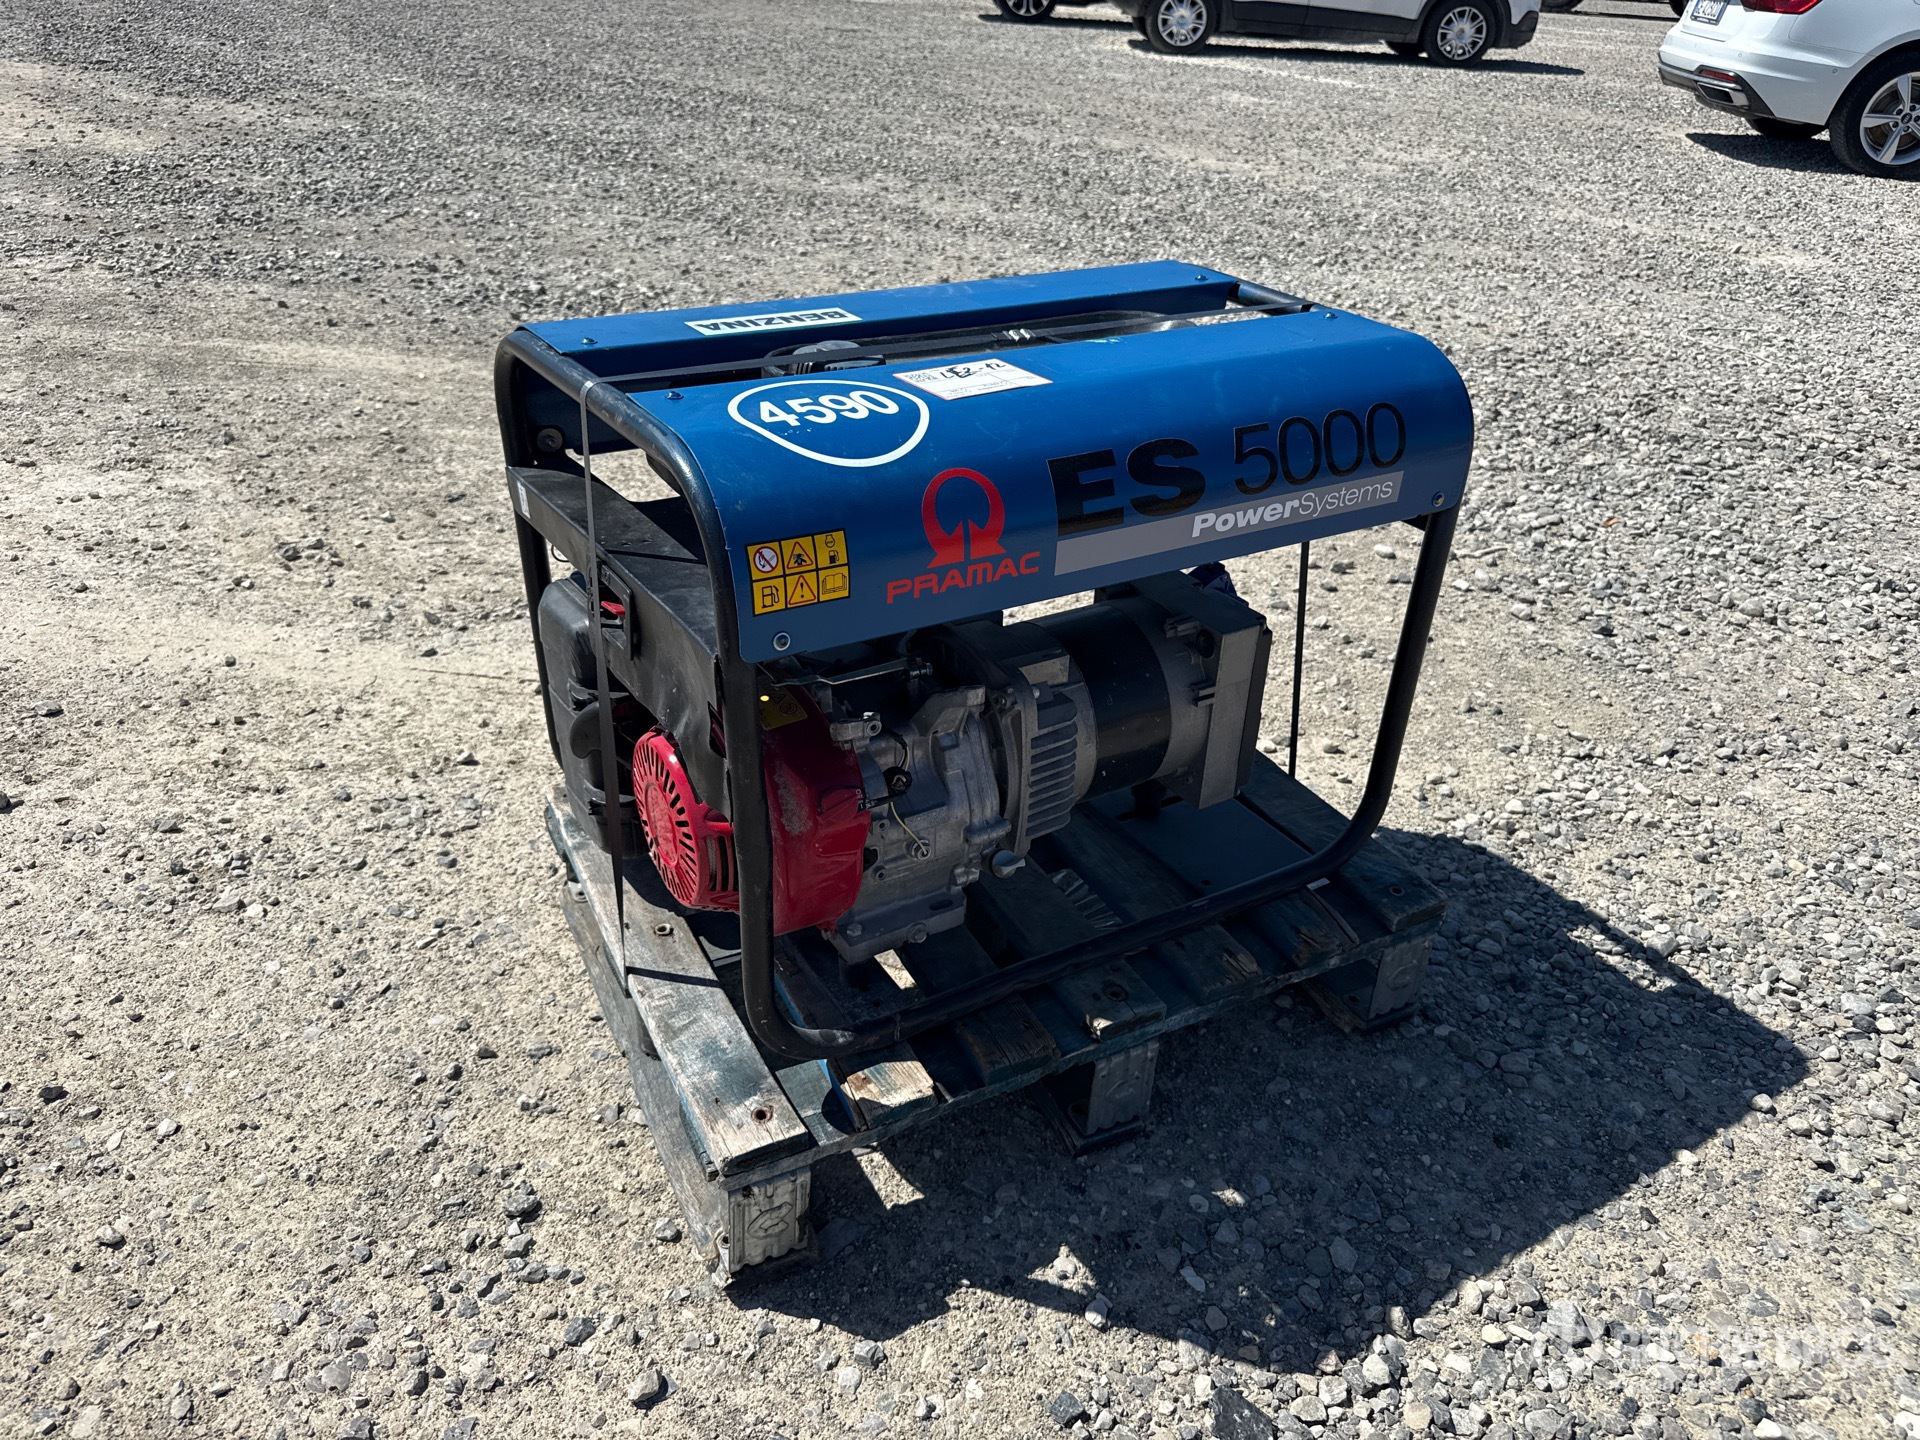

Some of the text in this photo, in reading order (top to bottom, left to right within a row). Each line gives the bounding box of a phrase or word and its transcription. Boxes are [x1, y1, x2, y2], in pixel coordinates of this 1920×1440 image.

[696, 310, 848, 331] BENZINA
[759, 390, 899, 427] 4590
[1046, 402, 1406, 537] ES 5000
[887, 551, 1041, 604] PRAMAC
